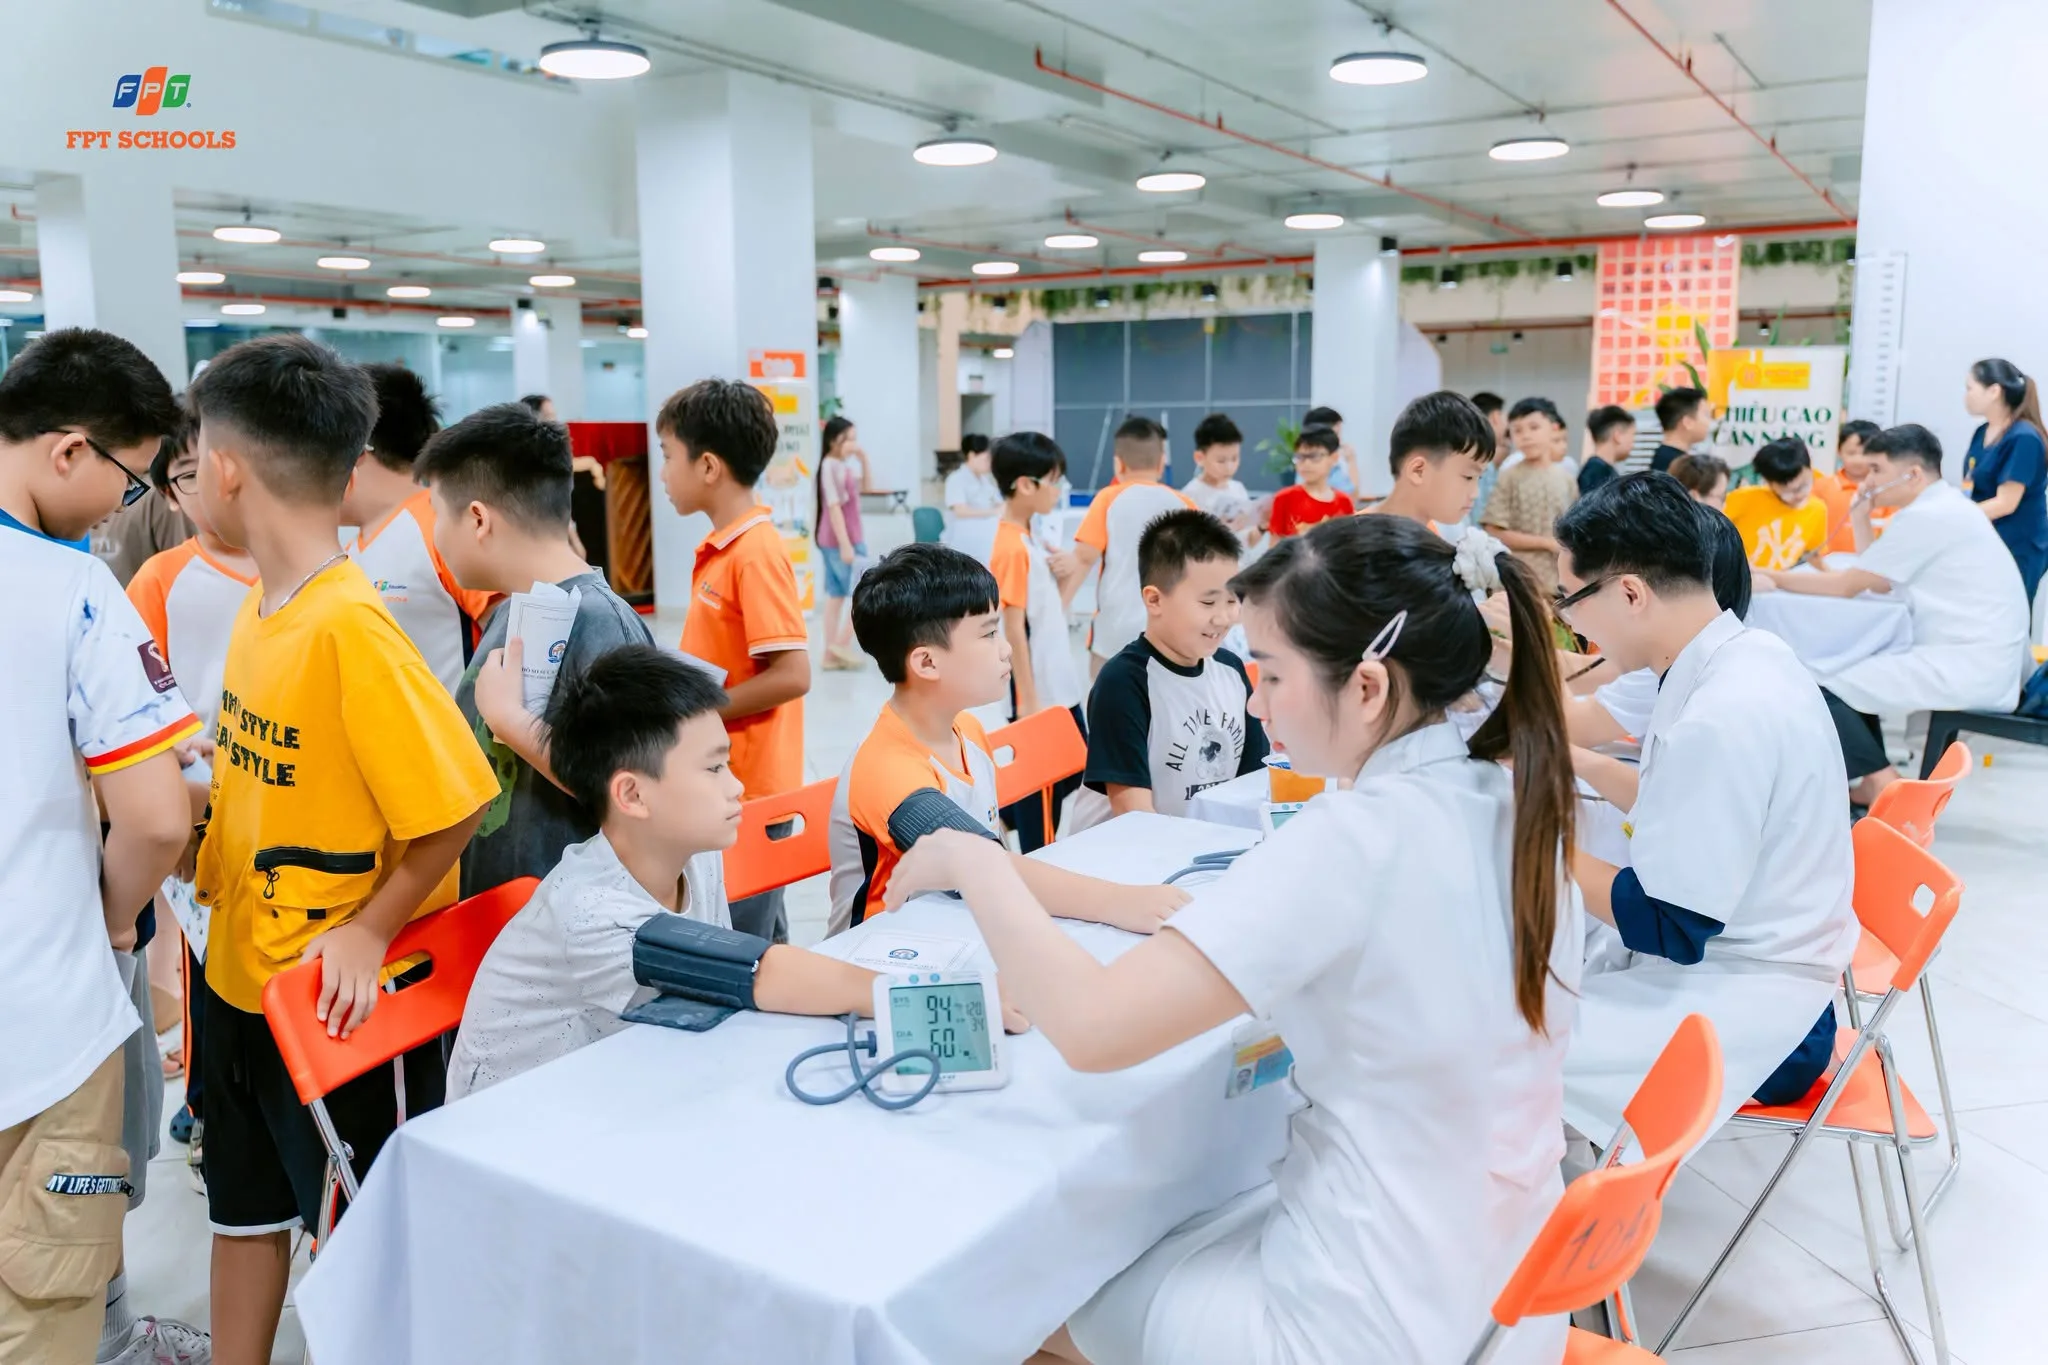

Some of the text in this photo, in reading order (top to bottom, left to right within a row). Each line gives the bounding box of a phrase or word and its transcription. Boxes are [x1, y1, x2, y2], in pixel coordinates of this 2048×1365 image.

[1782, 406, 1833, 424] CAO
[240, 708, 300, 750] STYLE
[230, 741, 296, 787] STYLE
[1165, 742, 1189, 771] ALL
[926, 995, 951, 1025] 94
[930, 1028, 955, 1058] 60
